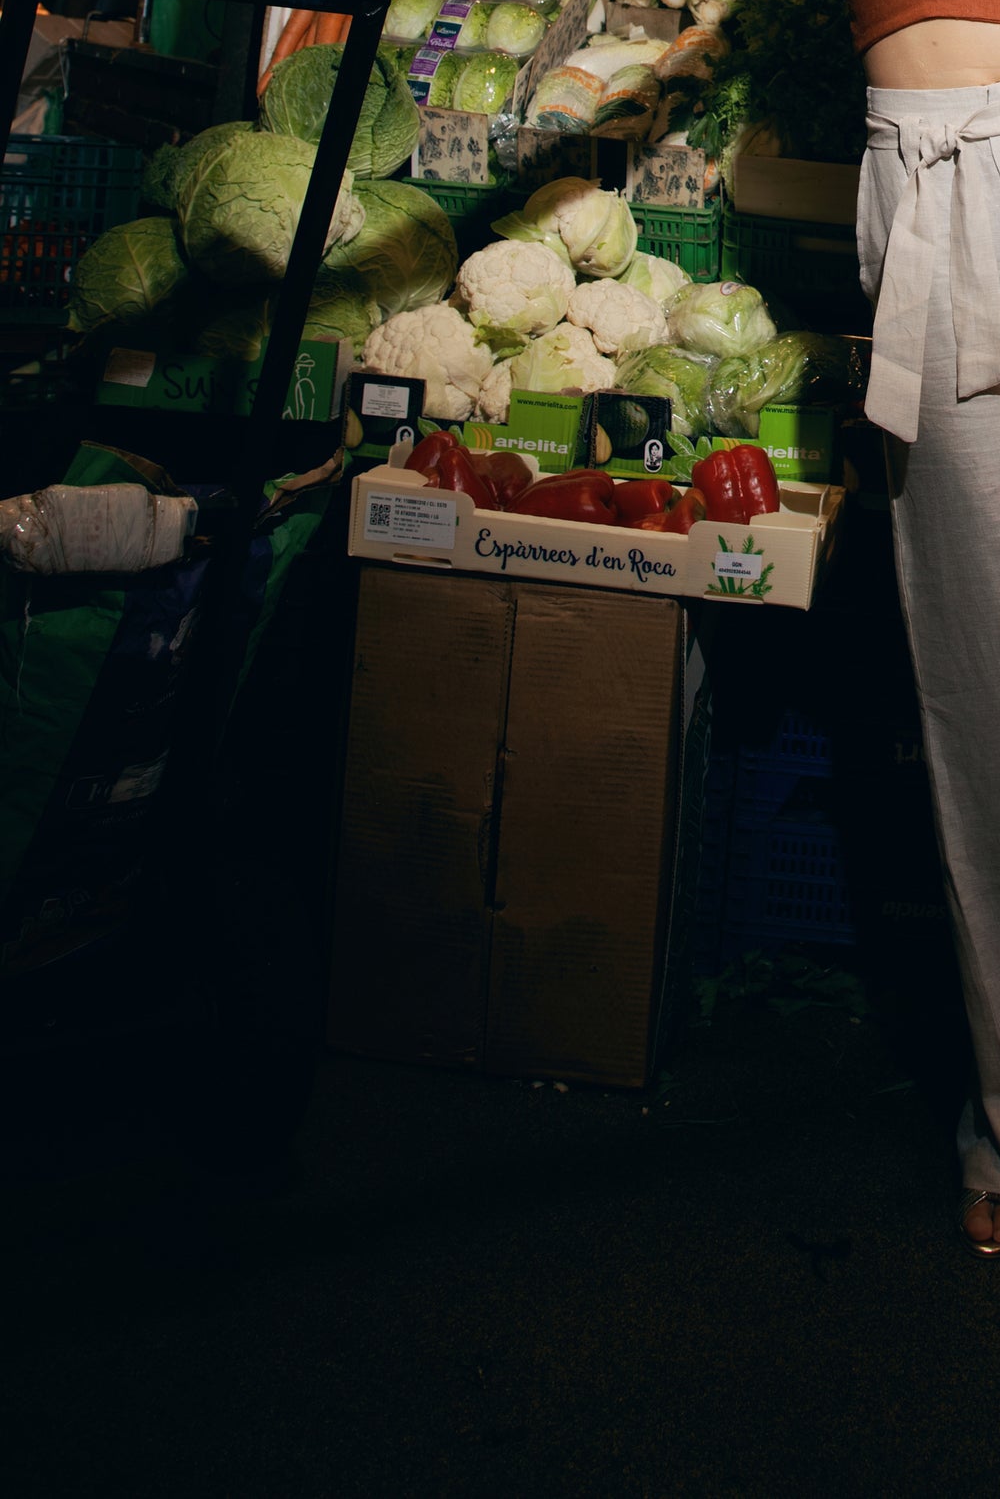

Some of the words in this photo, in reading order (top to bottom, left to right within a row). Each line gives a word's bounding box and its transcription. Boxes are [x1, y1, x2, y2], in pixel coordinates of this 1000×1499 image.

[516, 398, 578, 410] www.marielita.com
[763, 445, 821, 460] ielita
[474, 528, 580, 570] Espàrrecs
[585, 546, 626, 571] d'en
[628, 548, 676, 583] Roca
